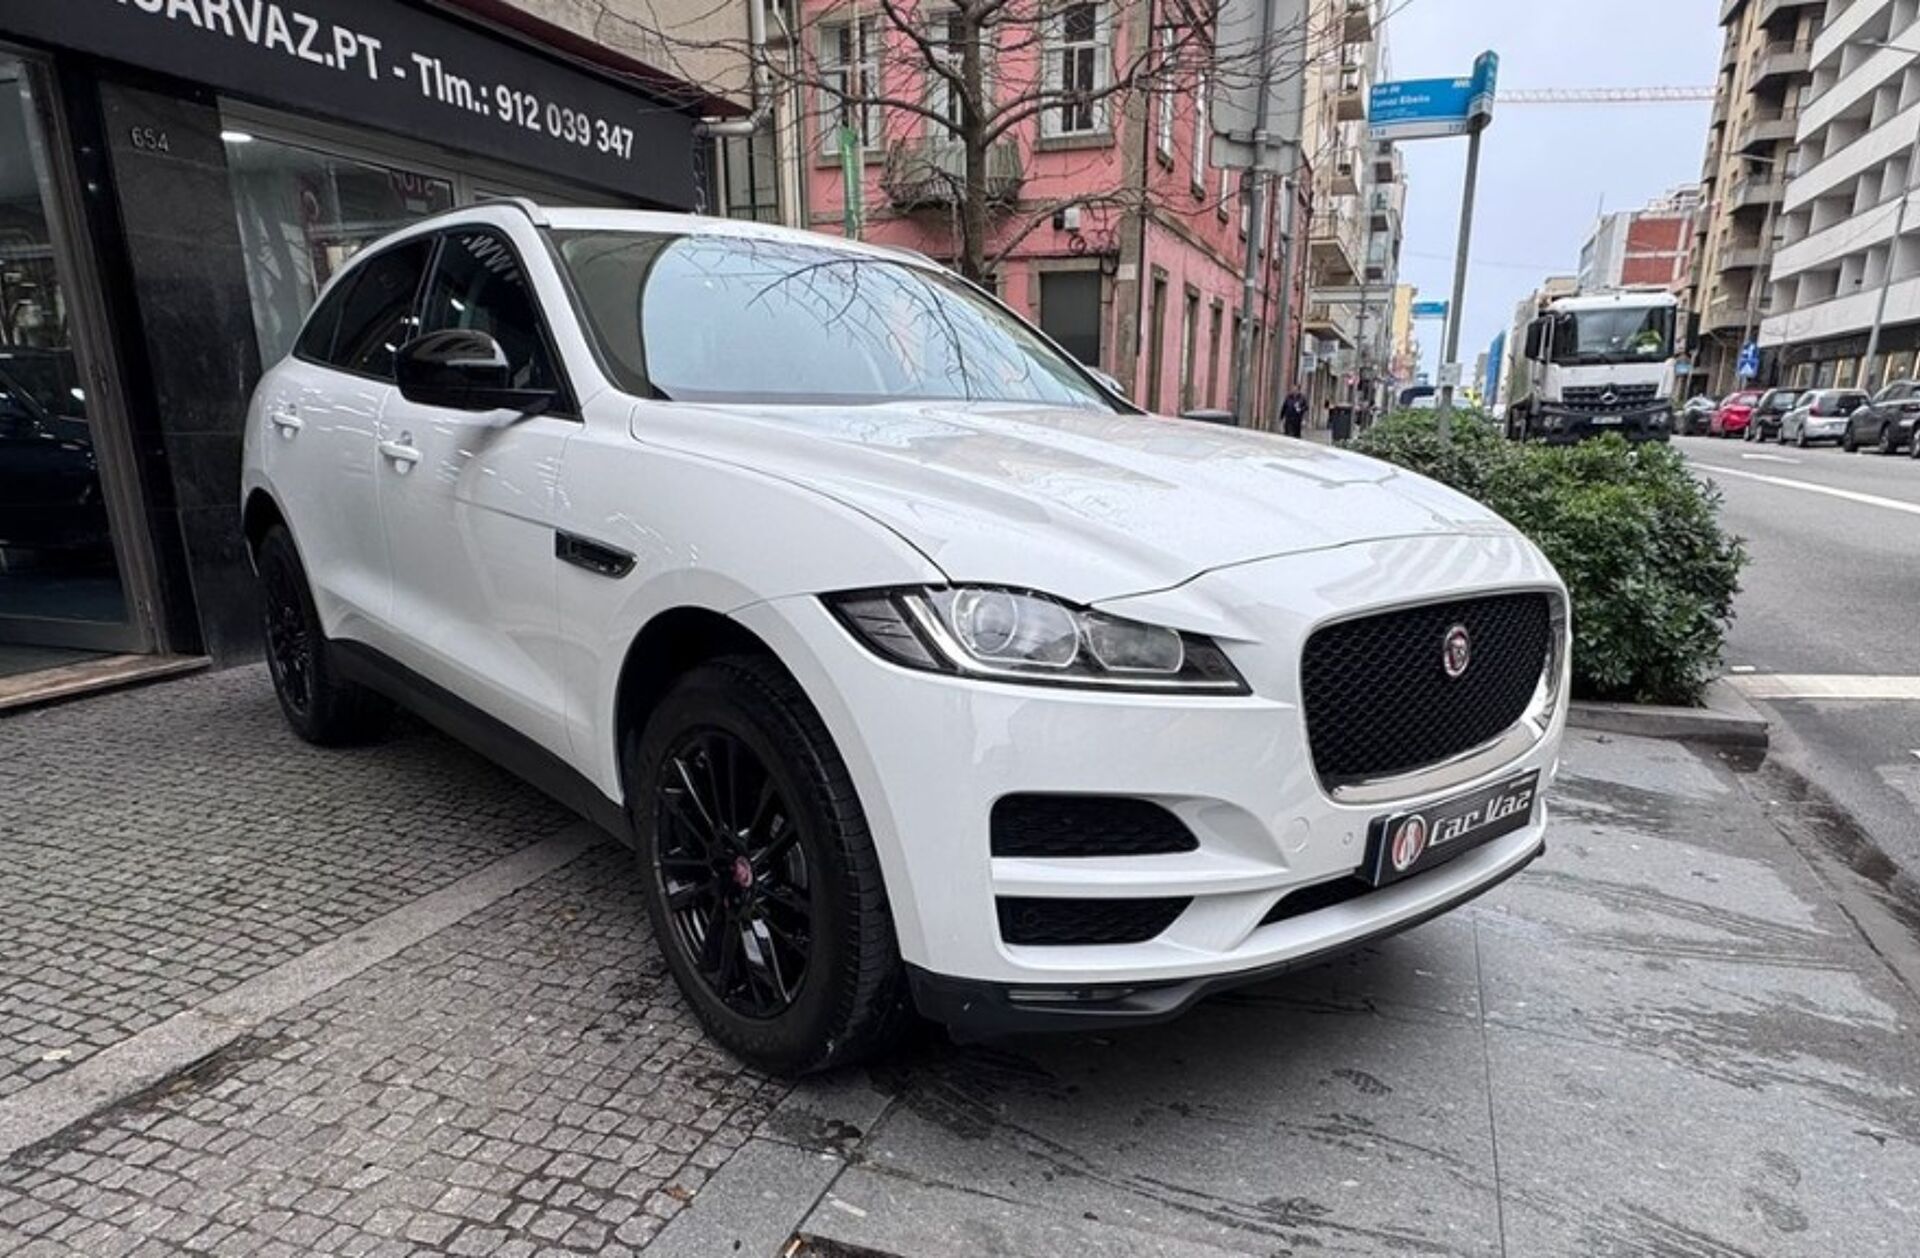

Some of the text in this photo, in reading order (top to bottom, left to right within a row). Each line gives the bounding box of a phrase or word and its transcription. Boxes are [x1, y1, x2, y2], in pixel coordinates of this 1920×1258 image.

[411, 52, 490, 116] Tlm.:
[496, 84, 541, 131] 912
[546, 102, 591, 147] 039
[595, 119, 634, 160] 347
[131, 126, 169, 151] 654
[1428, 790, 1531, 847] Car Vaz
